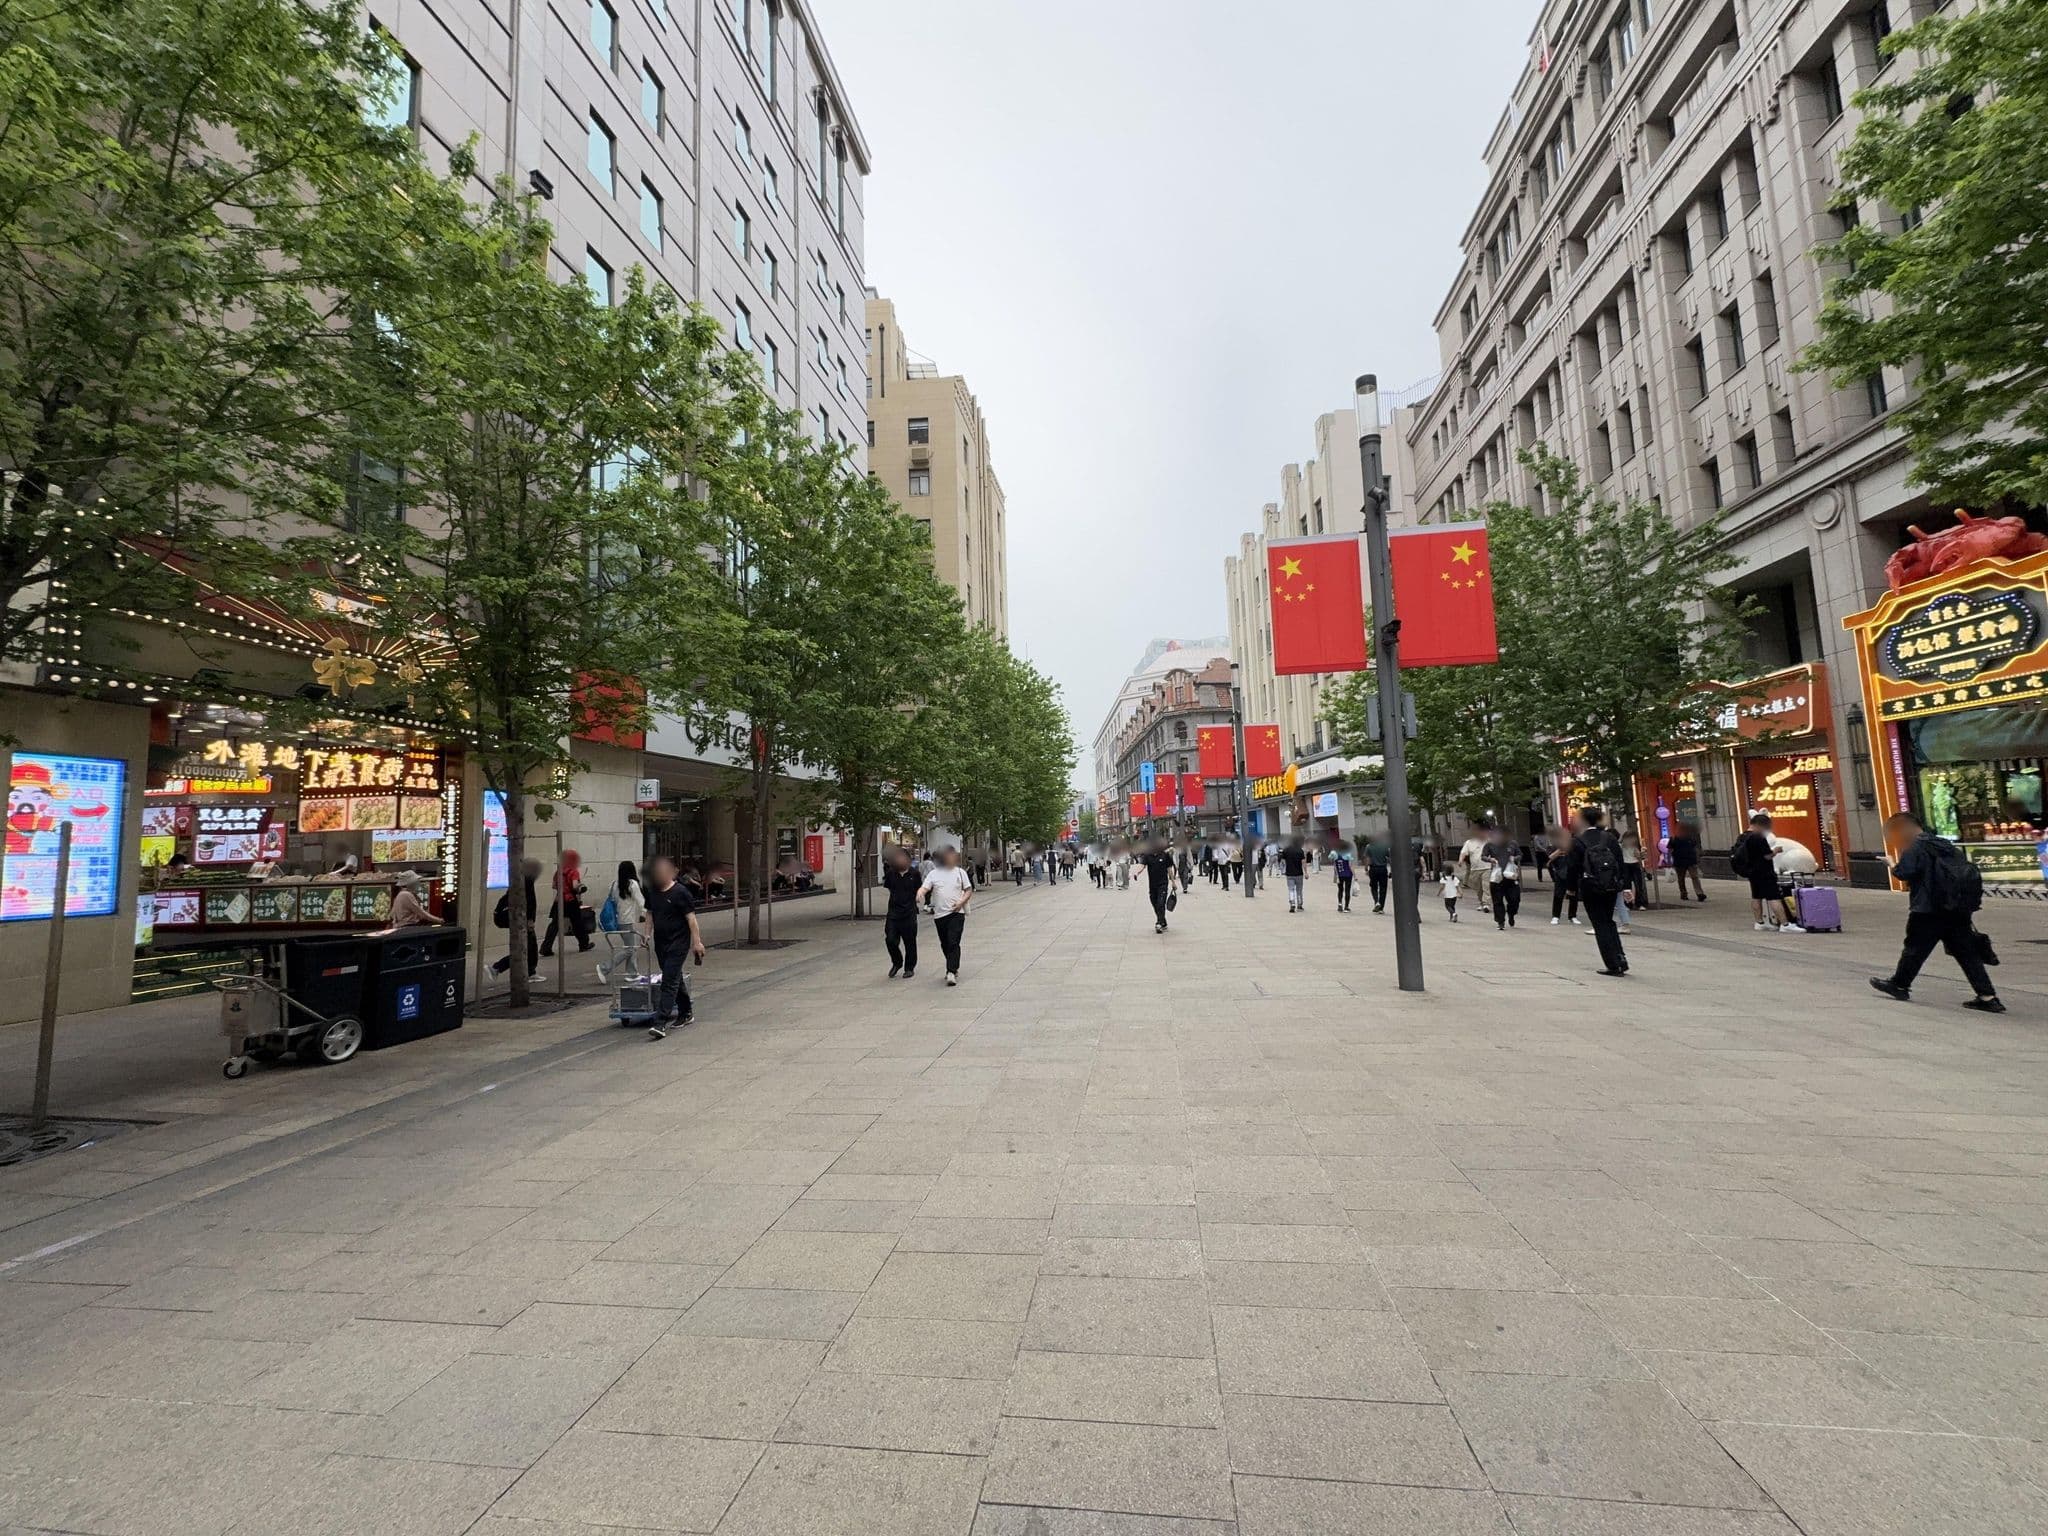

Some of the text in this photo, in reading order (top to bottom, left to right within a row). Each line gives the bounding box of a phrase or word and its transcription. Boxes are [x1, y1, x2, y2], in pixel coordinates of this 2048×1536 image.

[1892, 675, 2044, 713] 老上海特色小吃
[203, 739, 405, 781] 外滩地下美食街
[1794, 755, 1829, 772] 大白兔
[1757, 784, 1810, 802] 大白兔
[1974, 854, 2041, 864] 龙井冰
